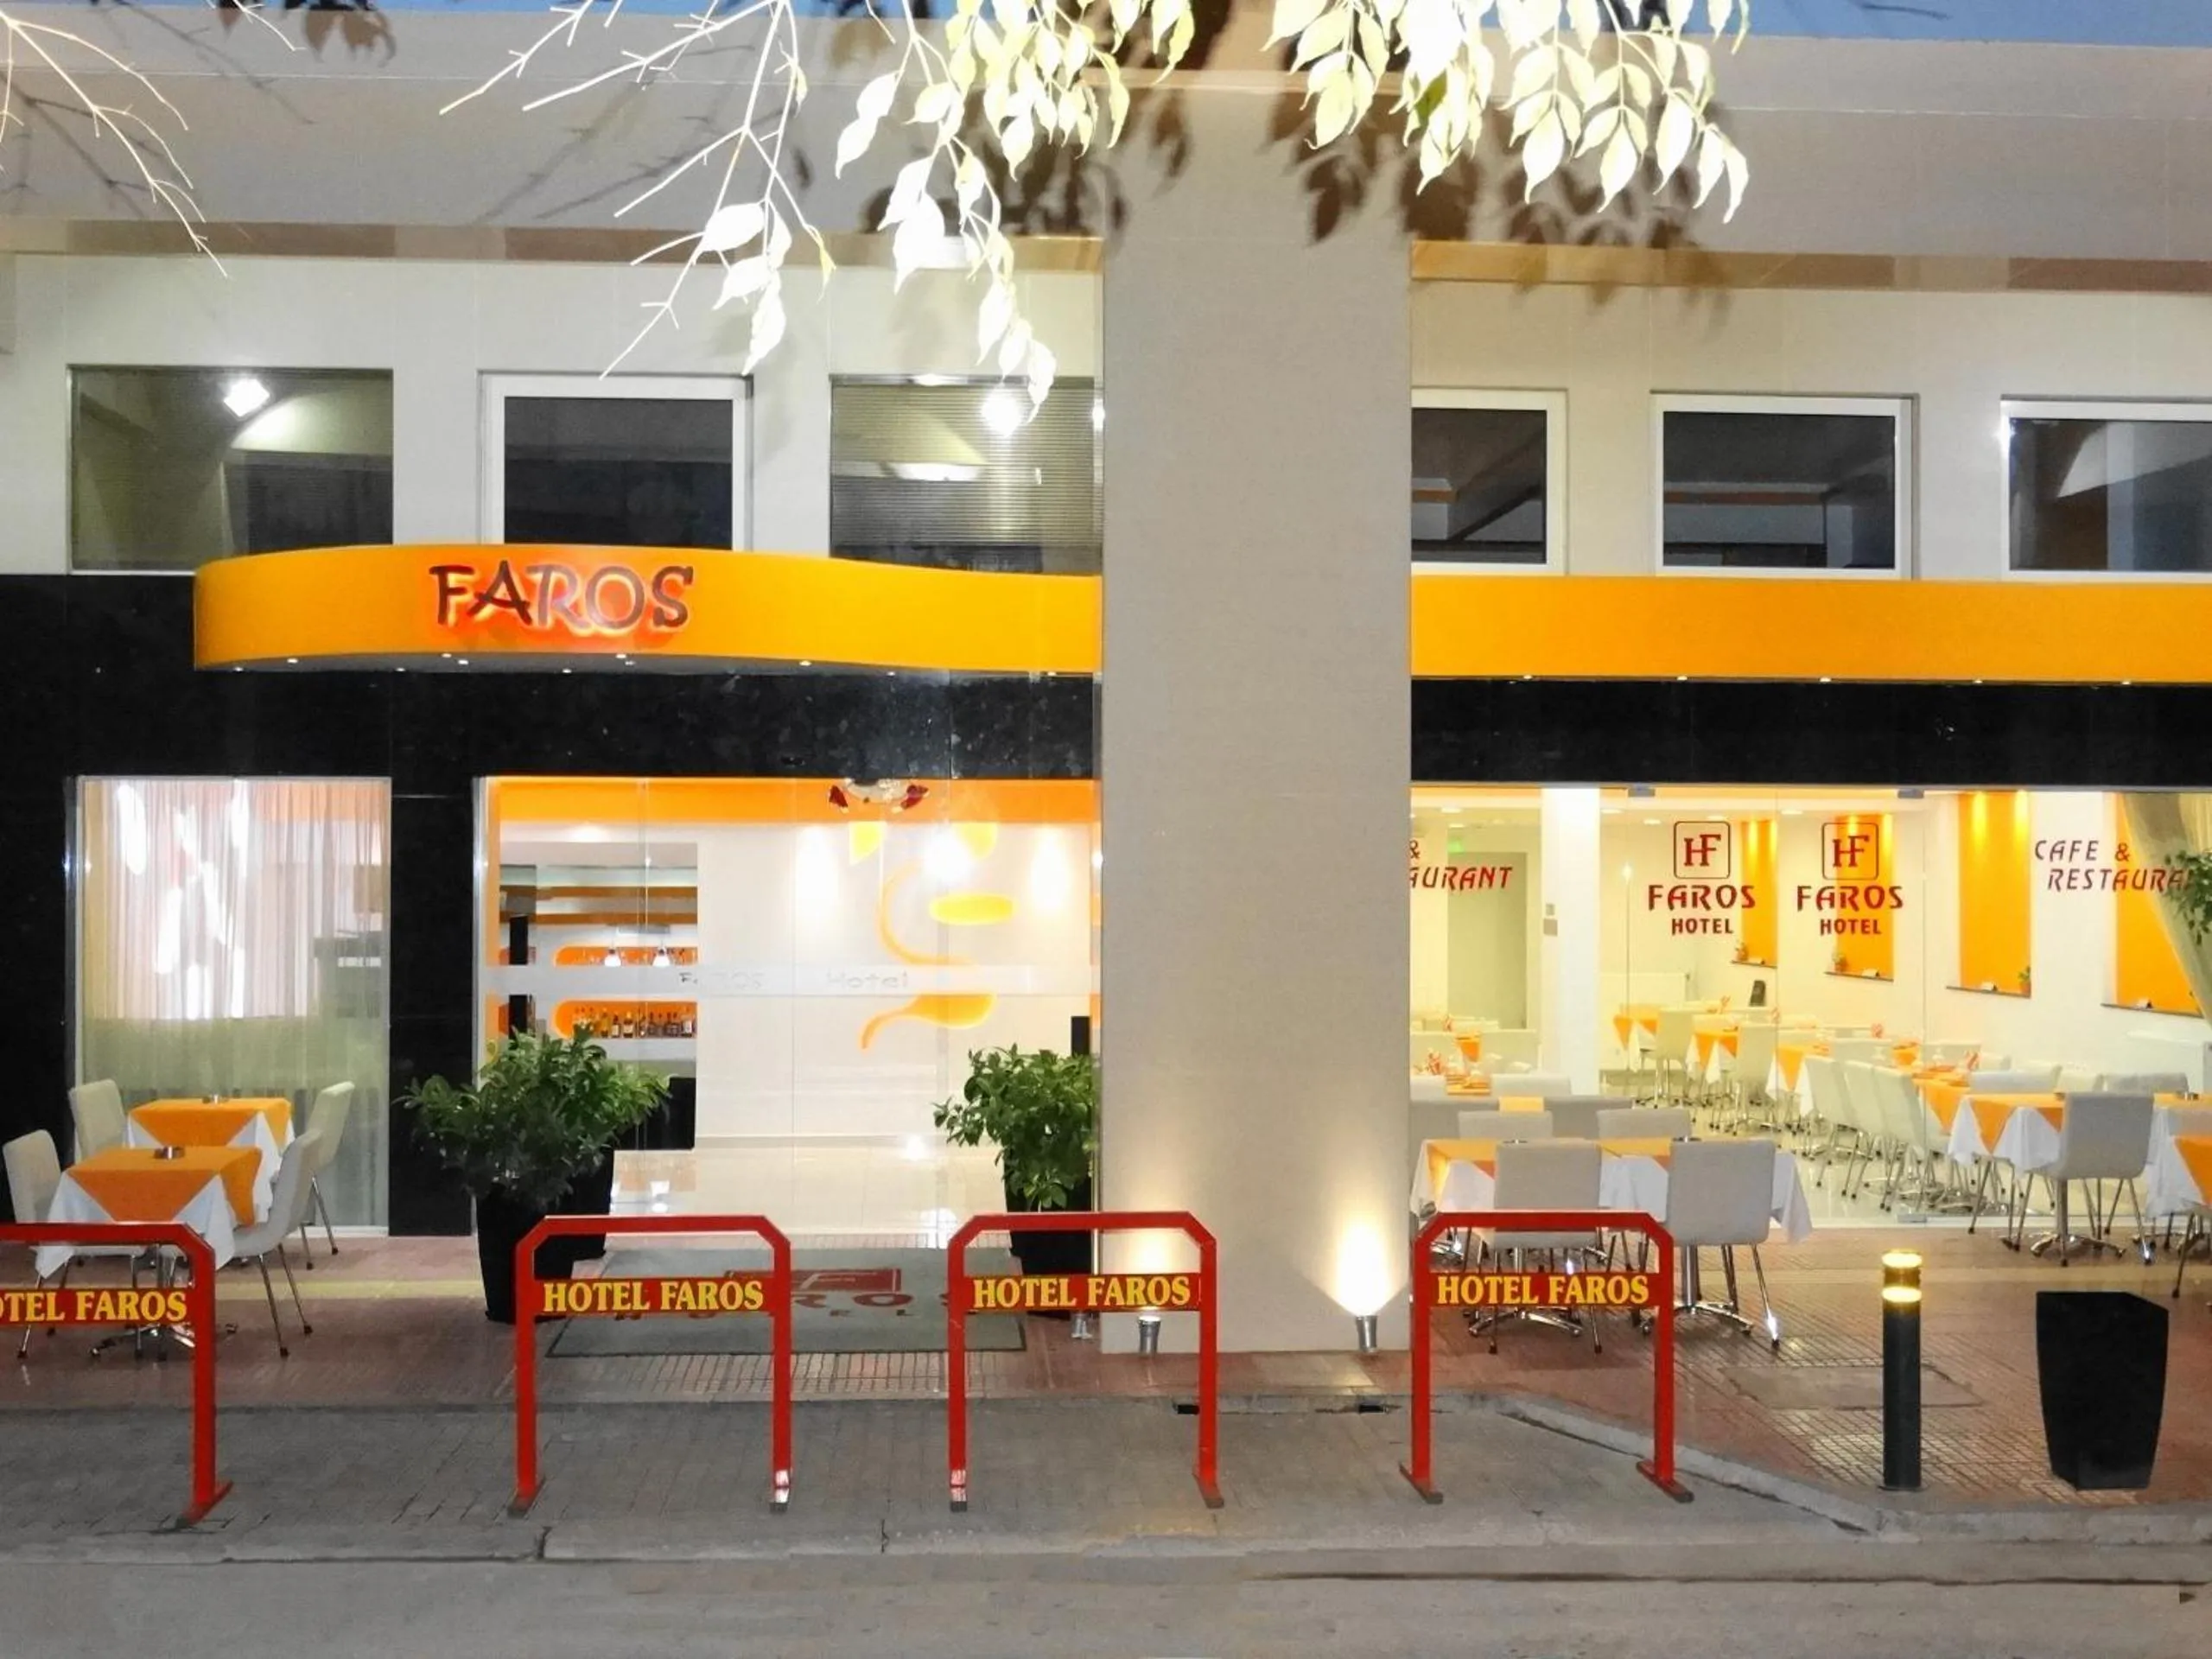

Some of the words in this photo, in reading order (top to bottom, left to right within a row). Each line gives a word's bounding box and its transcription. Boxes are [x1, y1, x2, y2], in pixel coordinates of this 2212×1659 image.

[429, 560, 694, 631] FAROS
[2034, 840, 2100, 862] CAFE
[2114, 842, 2131, 861] &
[1648, 884, 1756, 911] FAROS
[1796, 885, 1904, 912] FAROS
[1671, 918, 1734, 936] HOTEL
[1820, 918, 1882, 936] HOTEL
[826, 969, 908, 989] Hotel
[543, 1281, 651, 1312] HOTEL
[660, 1280, 764, 1311] FAROS
[973, 1278, 1077, 1308] HOTEL
[1087, 1275, 1191, 1306] FAROS
[1438, 1275, 1538, 1305] HOTEL
[1548, 1274, 1649, 1305] FAROS
[0, 1293, 65, 1322] TEL
[75, 1291, 188, 1321] FAROS
